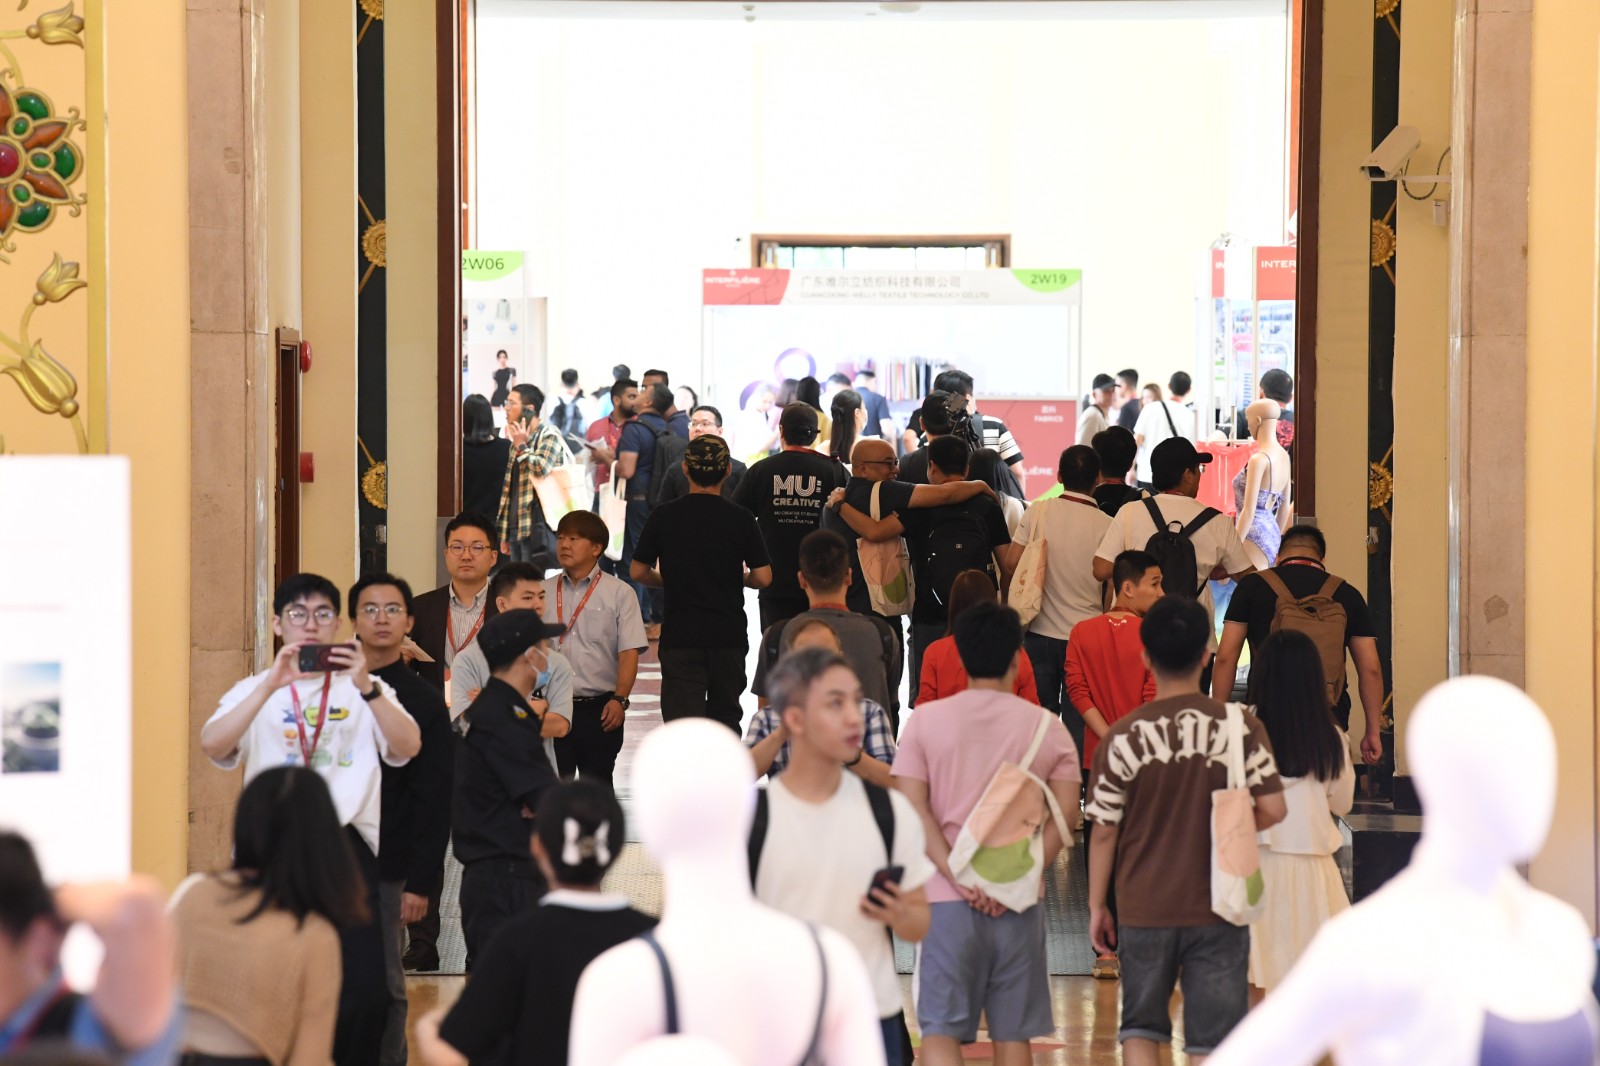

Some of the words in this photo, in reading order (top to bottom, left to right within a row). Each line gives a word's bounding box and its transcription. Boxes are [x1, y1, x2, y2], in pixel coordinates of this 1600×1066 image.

[1030, 273, 1067, 284] 2W19
[1034, 415, 1063, 423] FABRICS
[773, 498, 821, 508] CREATIVE
